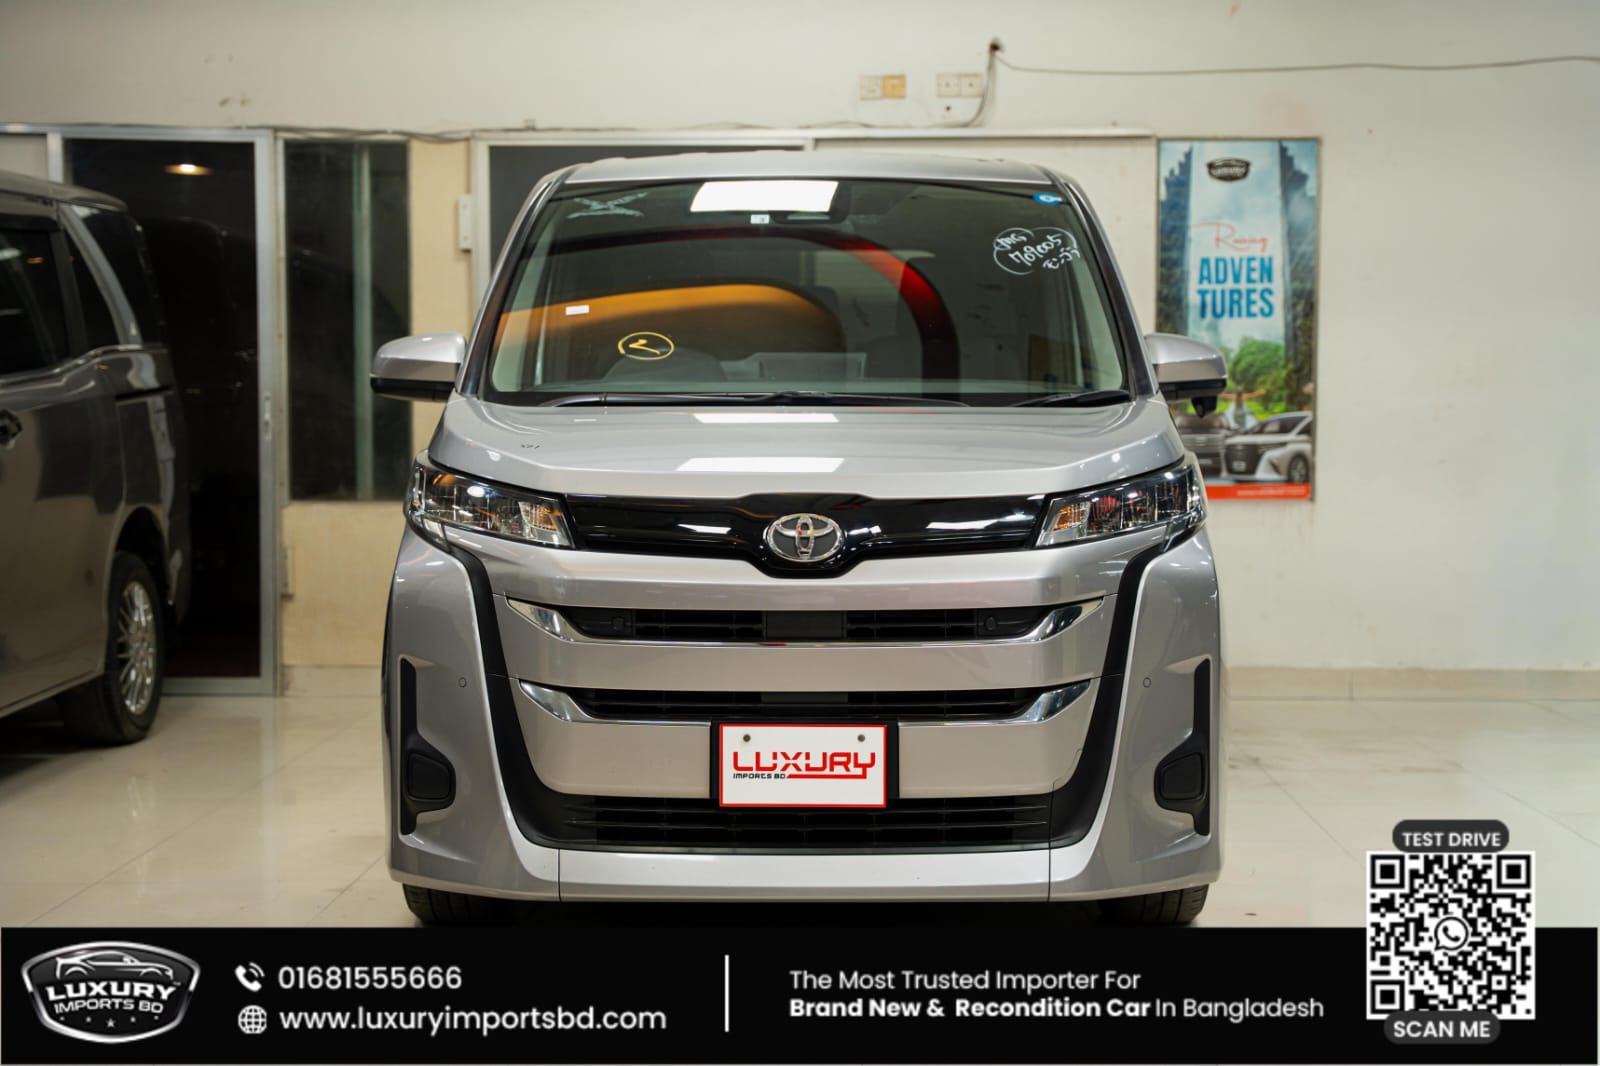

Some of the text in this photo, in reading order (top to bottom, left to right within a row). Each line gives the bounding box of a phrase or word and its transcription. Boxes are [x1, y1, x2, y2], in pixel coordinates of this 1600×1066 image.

[1198, 256, 1273, 285] ADVEN
[1197, 287, 1275, 319] TURES
[733, 751, 876, 774] LUXURY
[733, 772, 772, 780] IMPORTS
